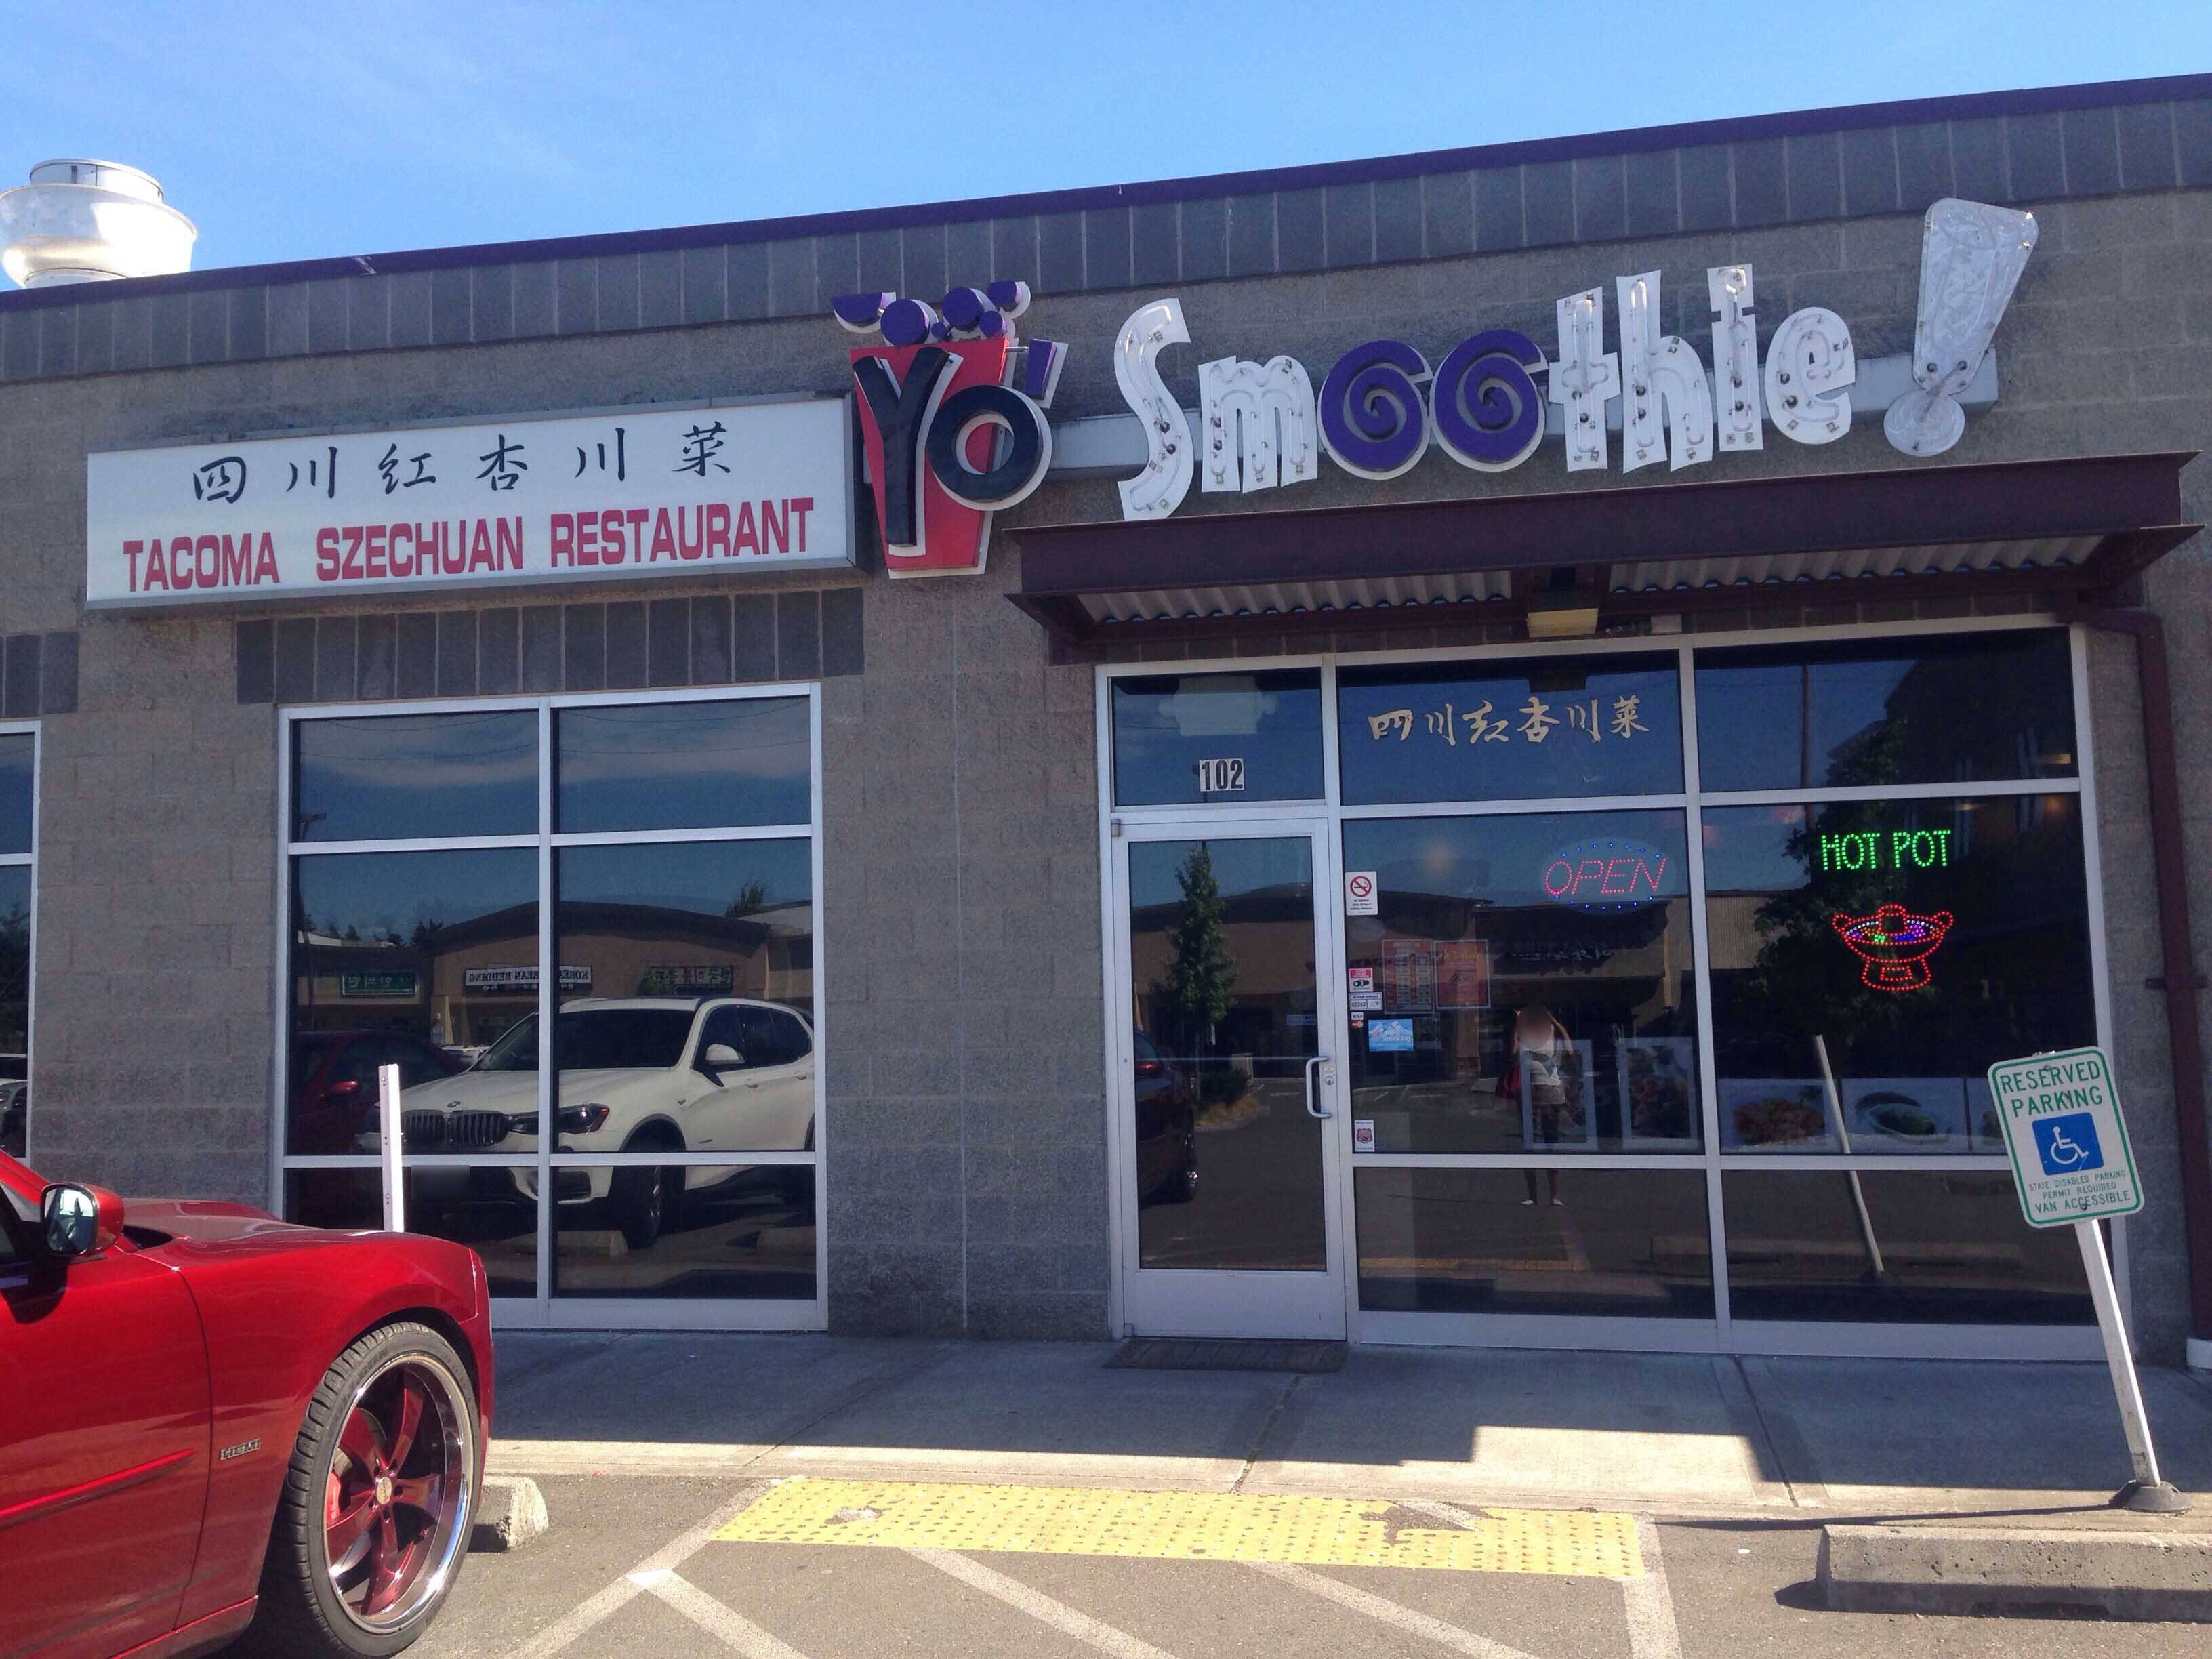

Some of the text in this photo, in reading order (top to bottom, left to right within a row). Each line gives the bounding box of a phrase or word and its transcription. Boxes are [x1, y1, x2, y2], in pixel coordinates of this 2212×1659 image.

[192, 421, 731, 504] 四川红杏川菜
[123, 497, 813, 592] TACOMA SZECHUAN RESTAURANT
[1368, 695, 1650, 746] 四川红杏川菜
[1200, 759, 1244, 791] 102
[1821, 830, 1952, 870] HOT POT
[1543, 857, 1667, 896] OPEN
[2000, 1060, 2100, 1094] RESERVED
[2011, 1086, 2102, 1118] PARKING
[2028, 1170, 2126, 1191] STATE DISABLED PARKING
[2043, 1182, 2116, 1200] PERMIT REQUIRED
[2035, 1190, 2131, 1214] VAN ACCESSIBLE
[220, 1437, 262, 1461] HEMI
